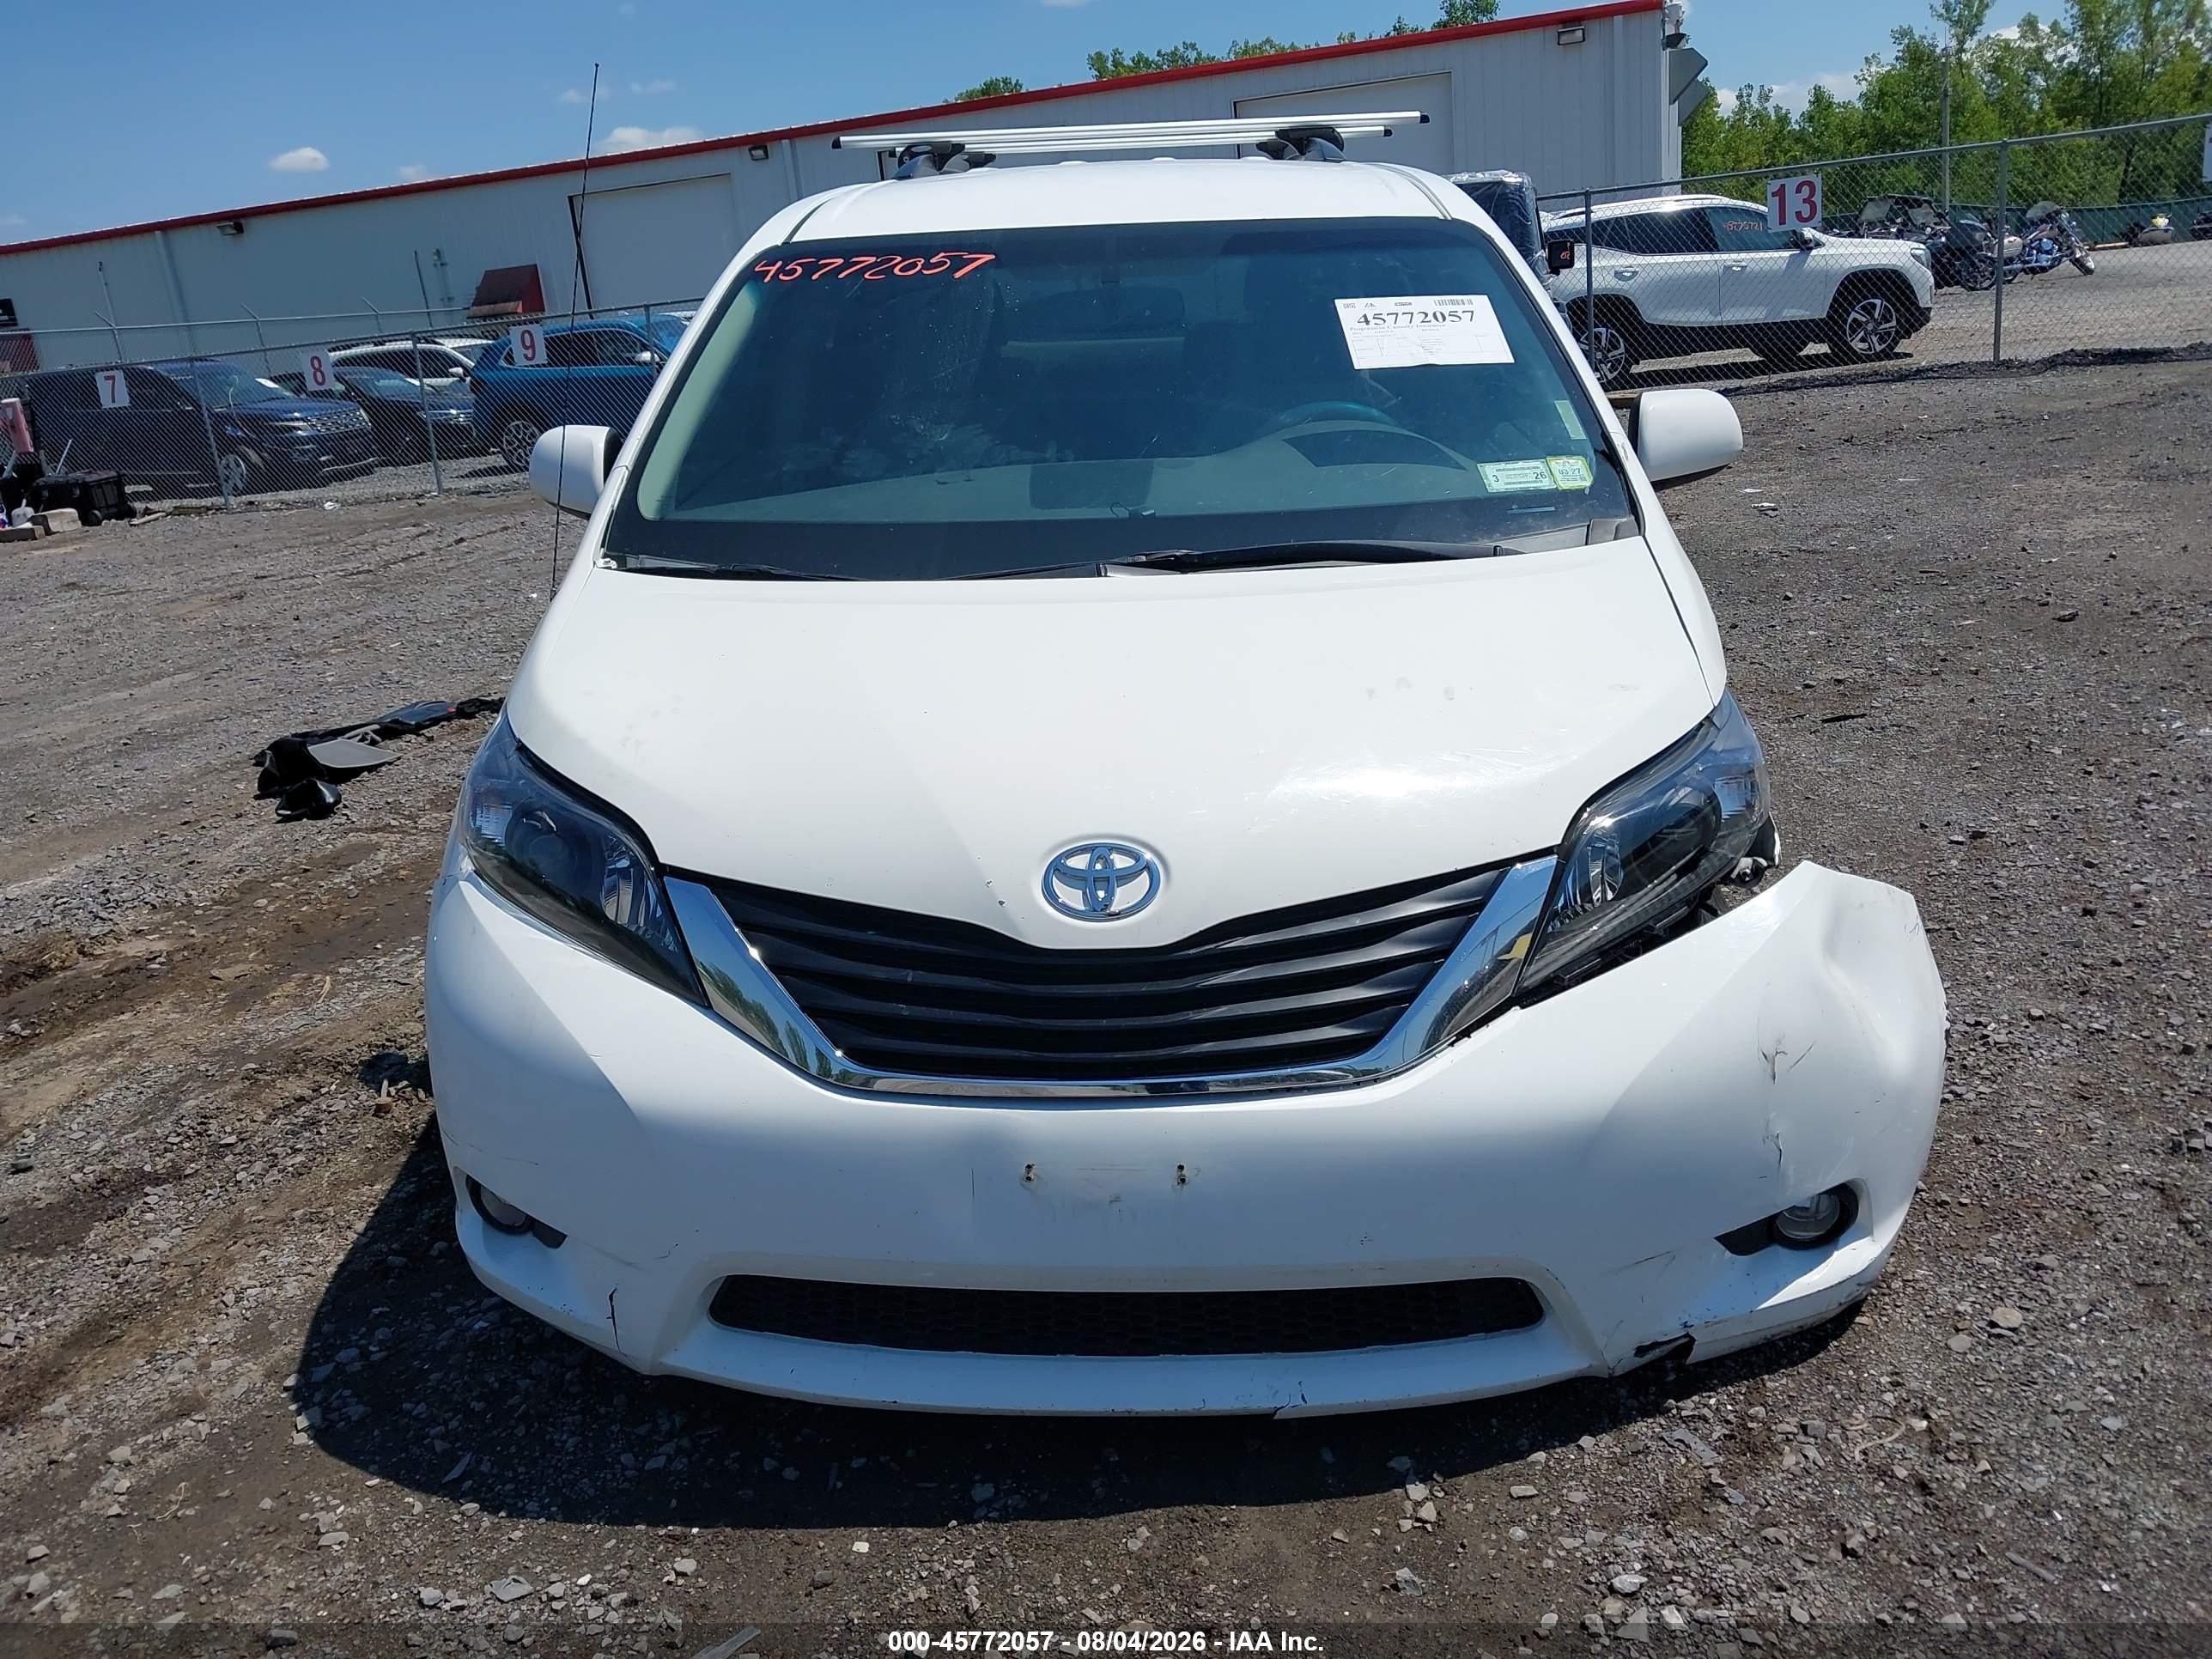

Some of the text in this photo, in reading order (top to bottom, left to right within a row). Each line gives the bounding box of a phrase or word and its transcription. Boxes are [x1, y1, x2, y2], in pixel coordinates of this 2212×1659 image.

[1771, 179, 1818, 226] 13
[754, 252, 996, 283] 45772057
[1357, 310, 1475, 326] 45772057
[520, 329, 537, 362] 9
[310, 356, 326, 386] 8
[104, 374, 116, 404] 7
[1533, 471, 1547, 480] 26
